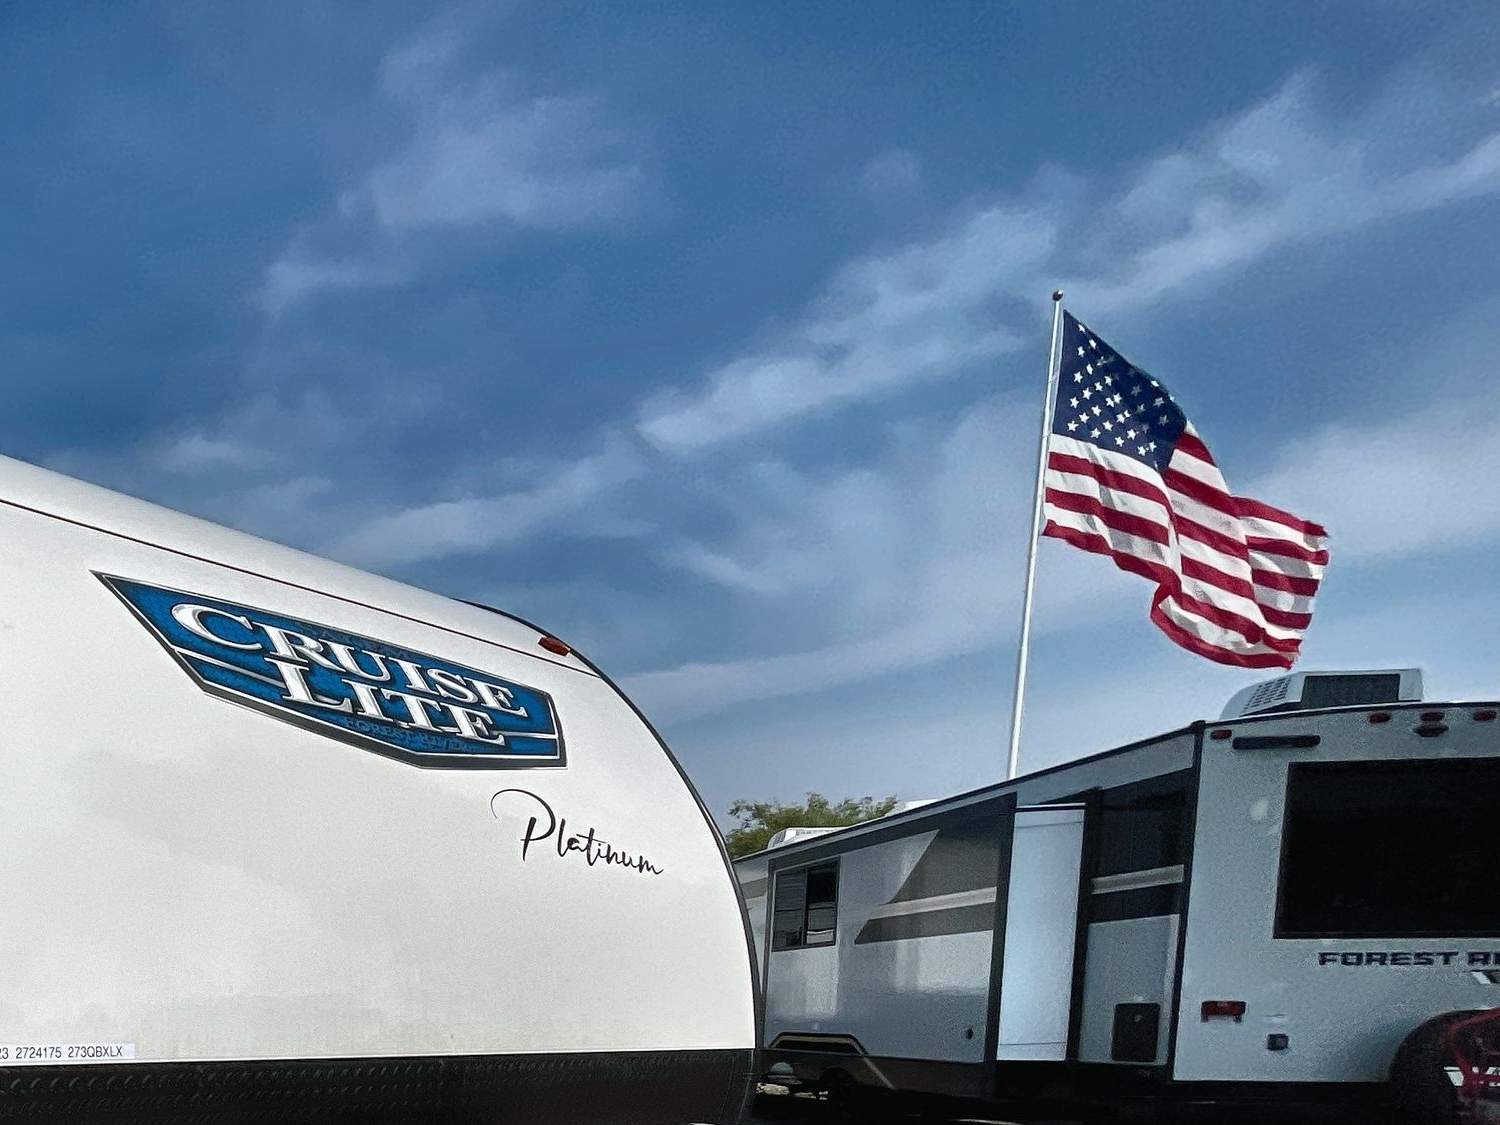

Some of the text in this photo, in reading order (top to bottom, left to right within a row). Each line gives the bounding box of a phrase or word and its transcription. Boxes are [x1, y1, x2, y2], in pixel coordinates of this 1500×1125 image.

[171, 603, 528, 718] CRUISE
[264, 658, 506, 746] LITE
[490, 788, 664, 876] Platinum
[1318, 951, 1459, 966] FOREST
[15, 1046, 62, 1060] 2724175
[68, 1045, 123, 1059] 273QBXLX
